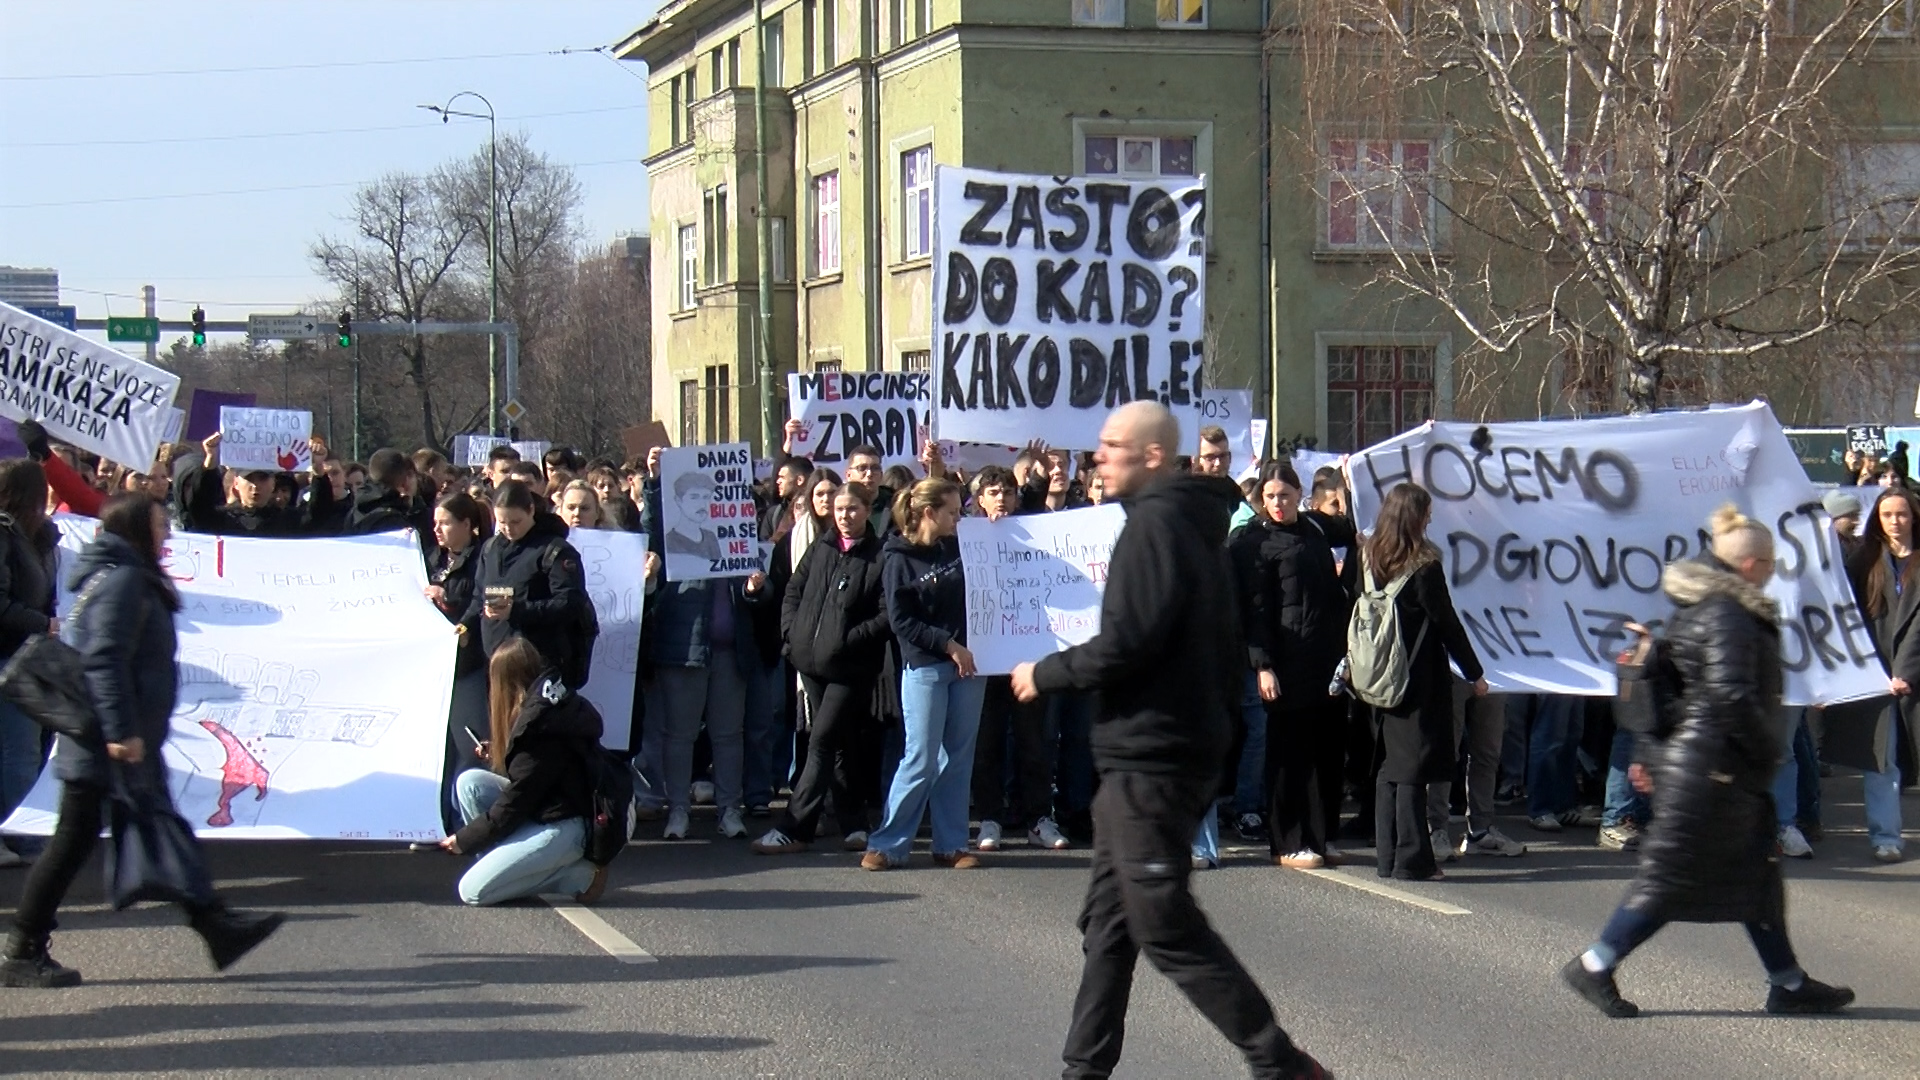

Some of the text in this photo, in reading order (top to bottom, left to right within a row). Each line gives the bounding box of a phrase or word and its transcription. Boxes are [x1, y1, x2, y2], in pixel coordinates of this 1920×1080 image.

[960, 176, 1206, 262] ZAŠTO?
[943, 252, 1199, 332] DO KAD?
[53, 347, 80, 372] SE
[82, 357, 110, 386] NE
[114, 369, 164, 408] VOZE
[941, 332, 1061, 411] KAKO
[697, 449, 748, 468] DANAS
[1671, 455, 1718, 470] ELLA
[709, 502, 756, 518] BILO KO
[717, 523, 757, 538] DA SE
[729, 541, 749, 554] NE
[1002, 611, 1040, 636] Missed
[1461, 605, 1554, 660] NE
